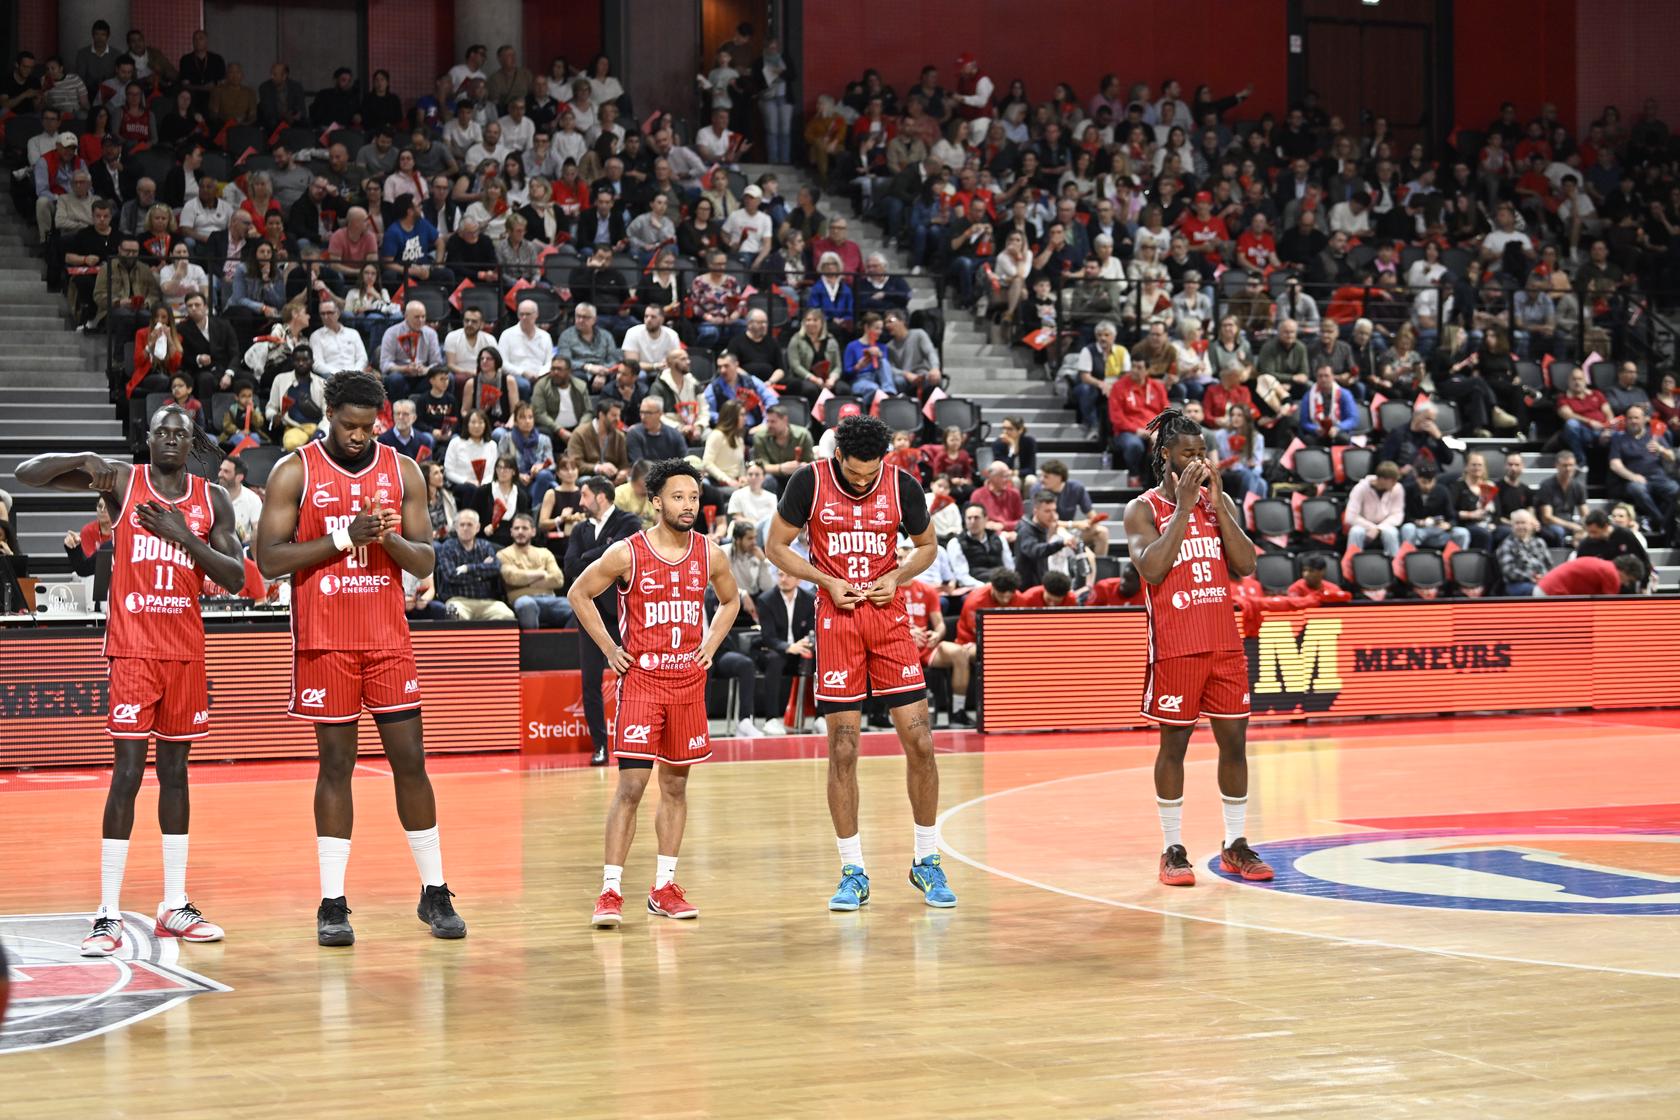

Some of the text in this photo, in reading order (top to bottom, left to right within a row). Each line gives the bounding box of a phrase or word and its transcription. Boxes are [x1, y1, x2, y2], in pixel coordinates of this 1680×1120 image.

[827, 531, 888, 556] BOURG
[1172, 536, 1221, 568] OURG
[346, 544, 368, 569] 20
[847, 556, 870, 578] 23
[154, 565, 174, 590] 11
[342, 575, 391, 586] PAPREC
[1191, 561, 1213, 583] 95
[146, 594, 192, 607] PAPREC
[342, 586, 380, 594] ENERGIES
[145, 605, 183, 614] ENERGIES
[644, 600, 700, 628] BOURG
[671, 626, 681, 649] 0
[1254, 618, 1512, 694] M MENEURS
